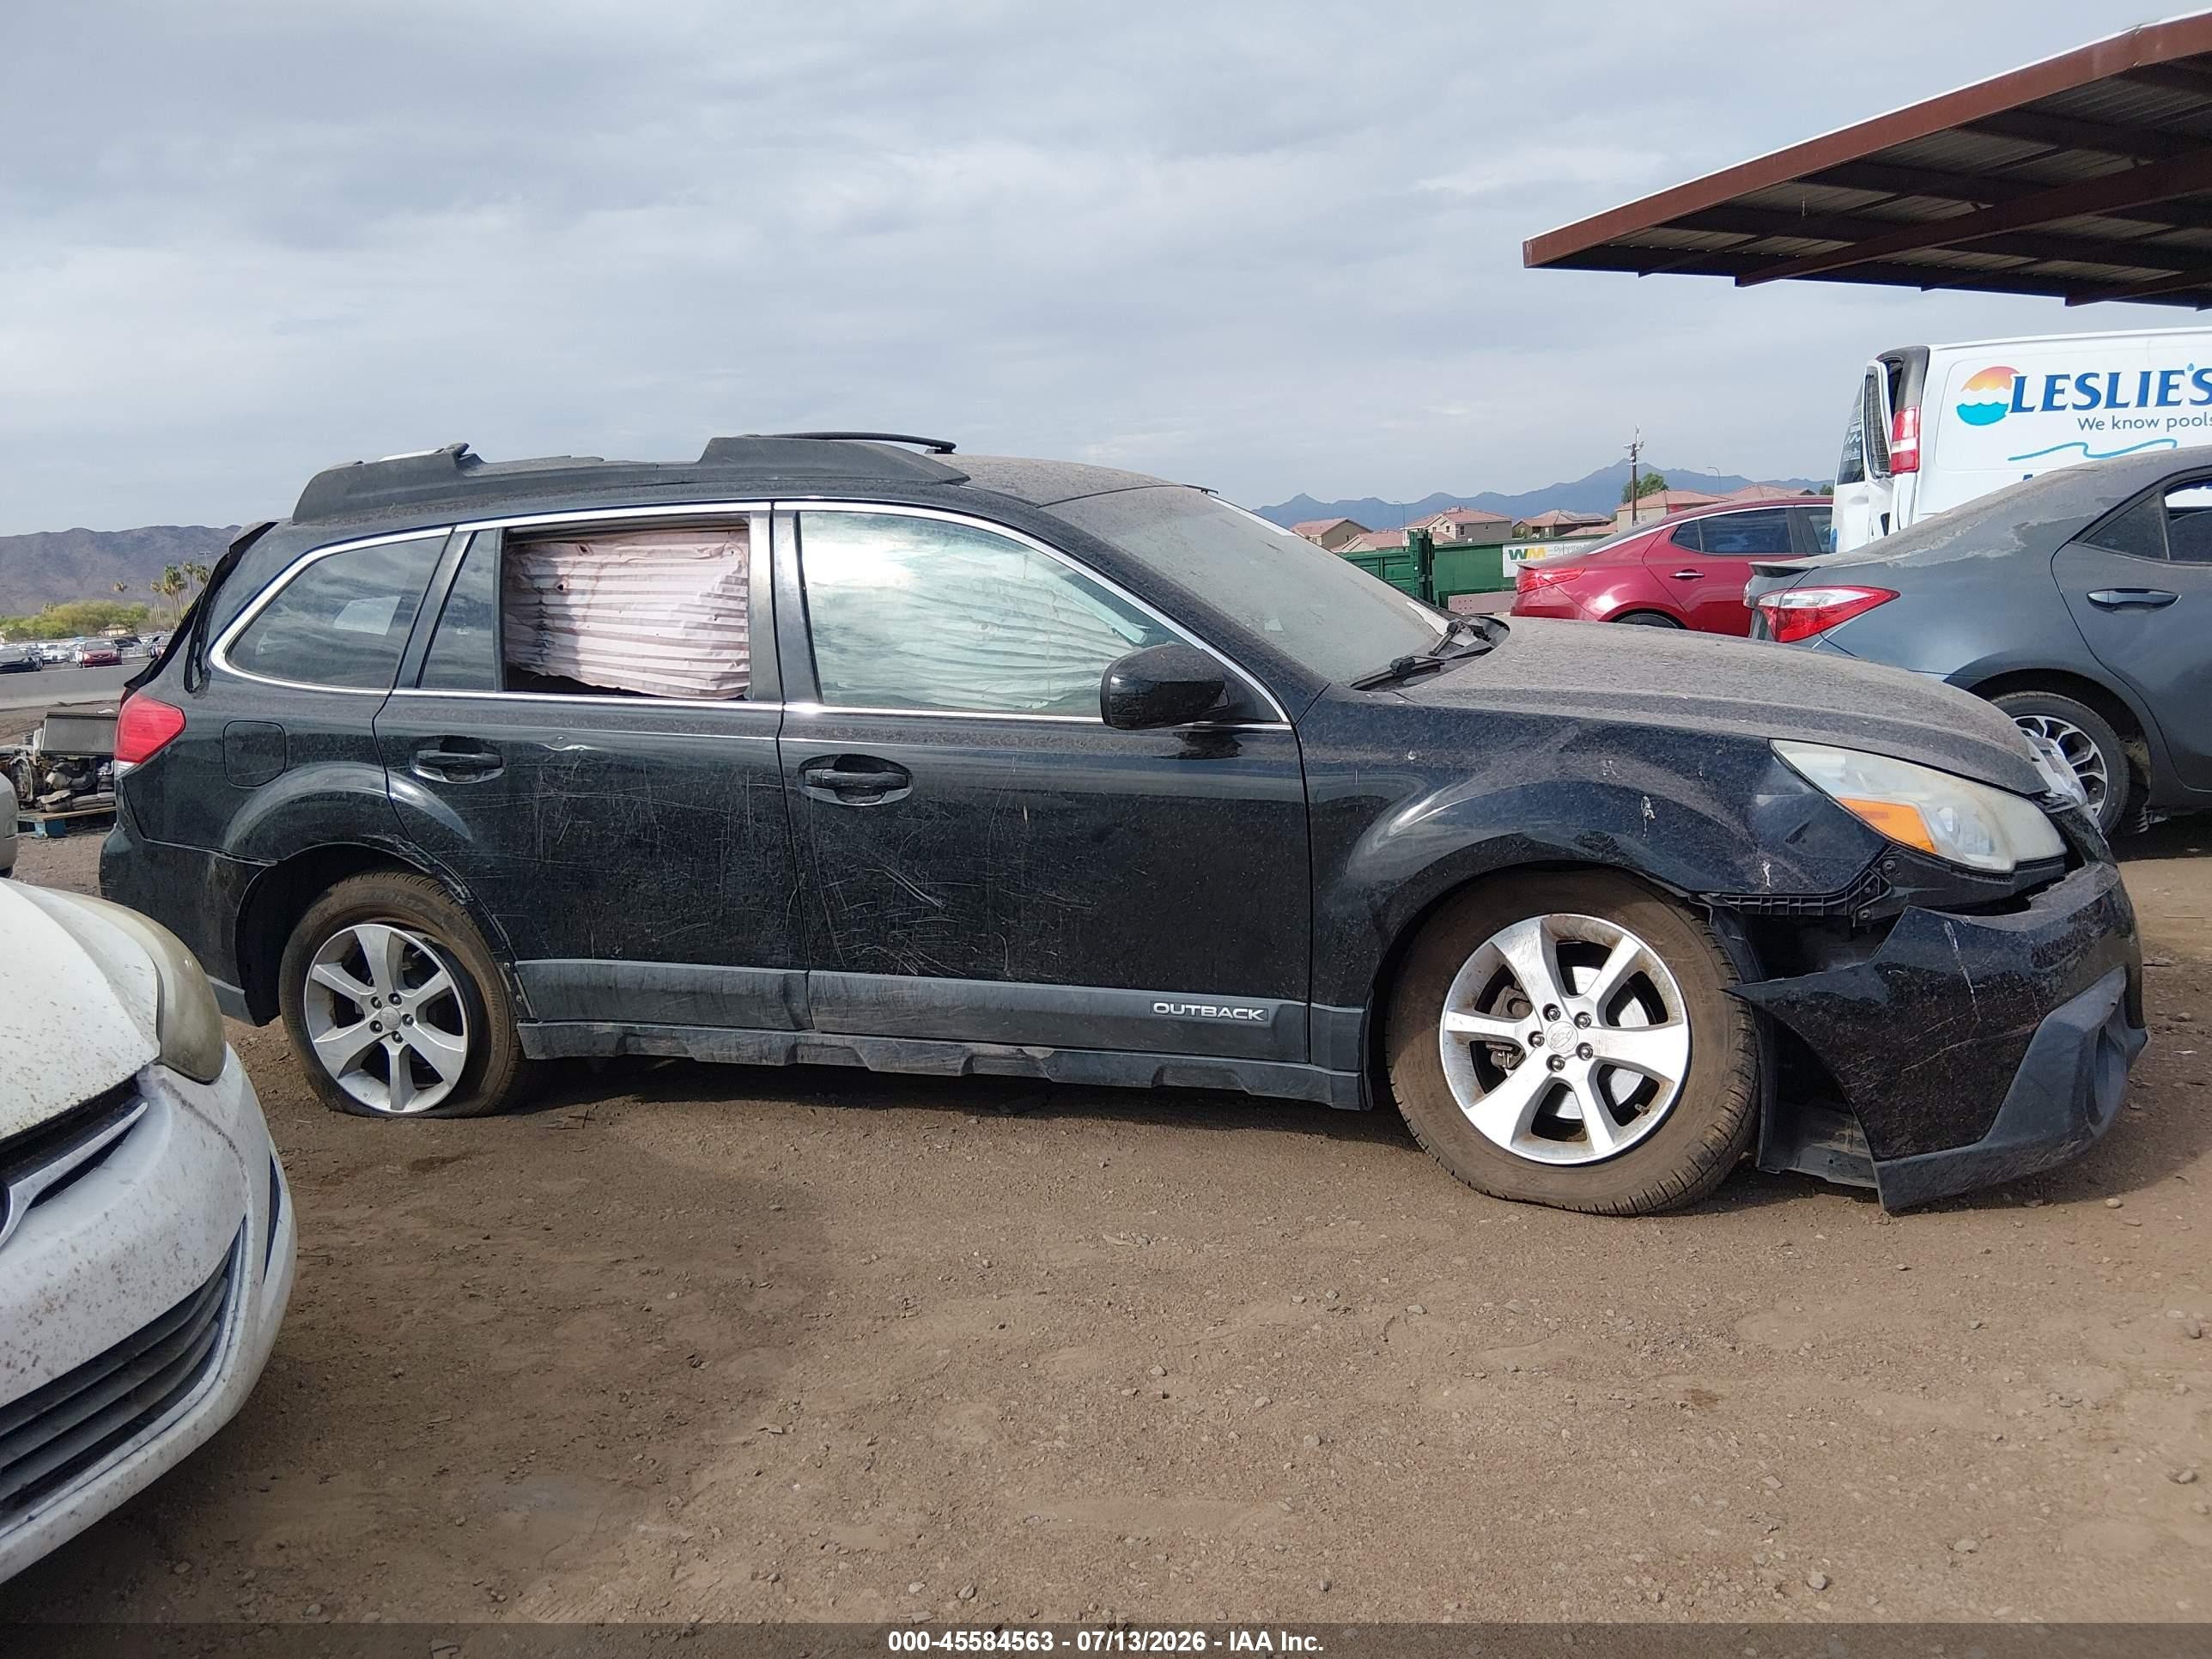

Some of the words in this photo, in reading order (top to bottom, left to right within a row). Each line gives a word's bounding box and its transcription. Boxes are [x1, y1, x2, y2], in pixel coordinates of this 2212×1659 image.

[2009, 363, 2212, 413] LESLIE'S
[2077, 416, 2106, 431] We
[2112, 414, 2160, 430] know
[1509, 547, 1546, 560] WM
[1153, 1002, 1265, 1021] OUTBACK
